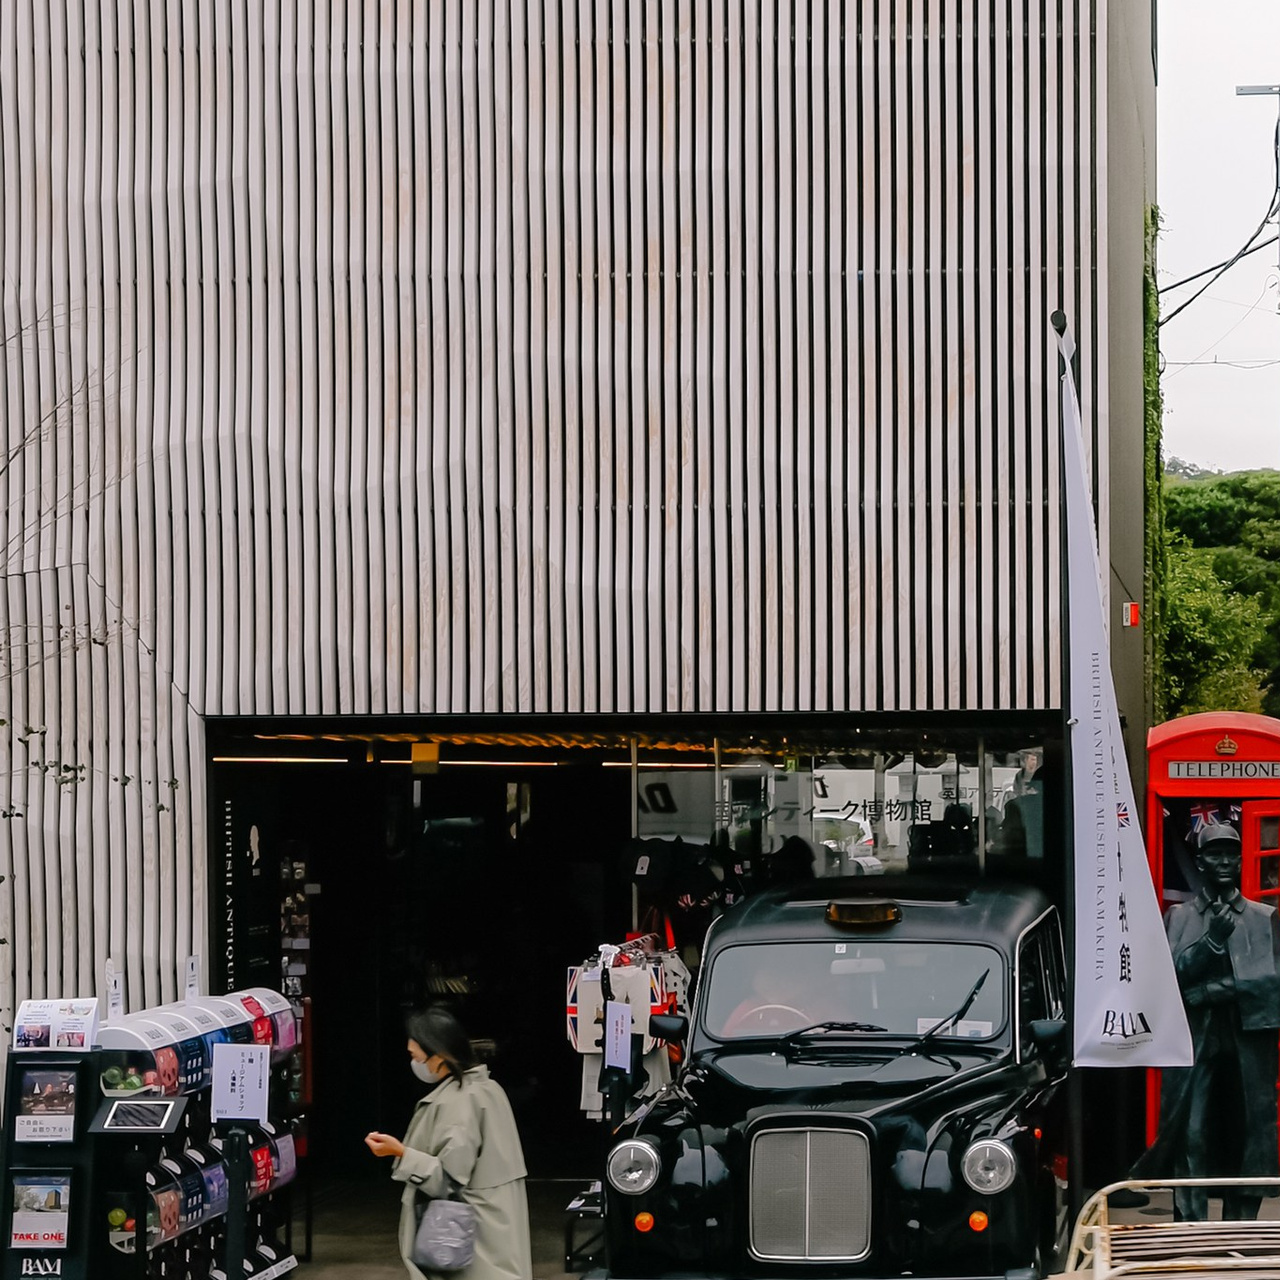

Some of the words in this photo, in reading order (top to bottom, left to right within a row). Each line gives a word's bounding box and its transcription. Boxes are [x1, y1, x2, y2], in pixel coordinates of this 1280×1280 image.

[1092, 652, 1102, 720] BRITISH
[1094, 726, 1104, 802] ANTIQUE
[1173, 762, 1280, 777] TELEPHONE
[1096, 808, 1105, 877] MUSEUM
[226, 894, 235, 991] ANTIQUE
[1096, 885, 1105, 981] KAMAKURA
[1102, 1010, 1152, 1039] BAM
[22, 1258, 61, 1275] BAM
